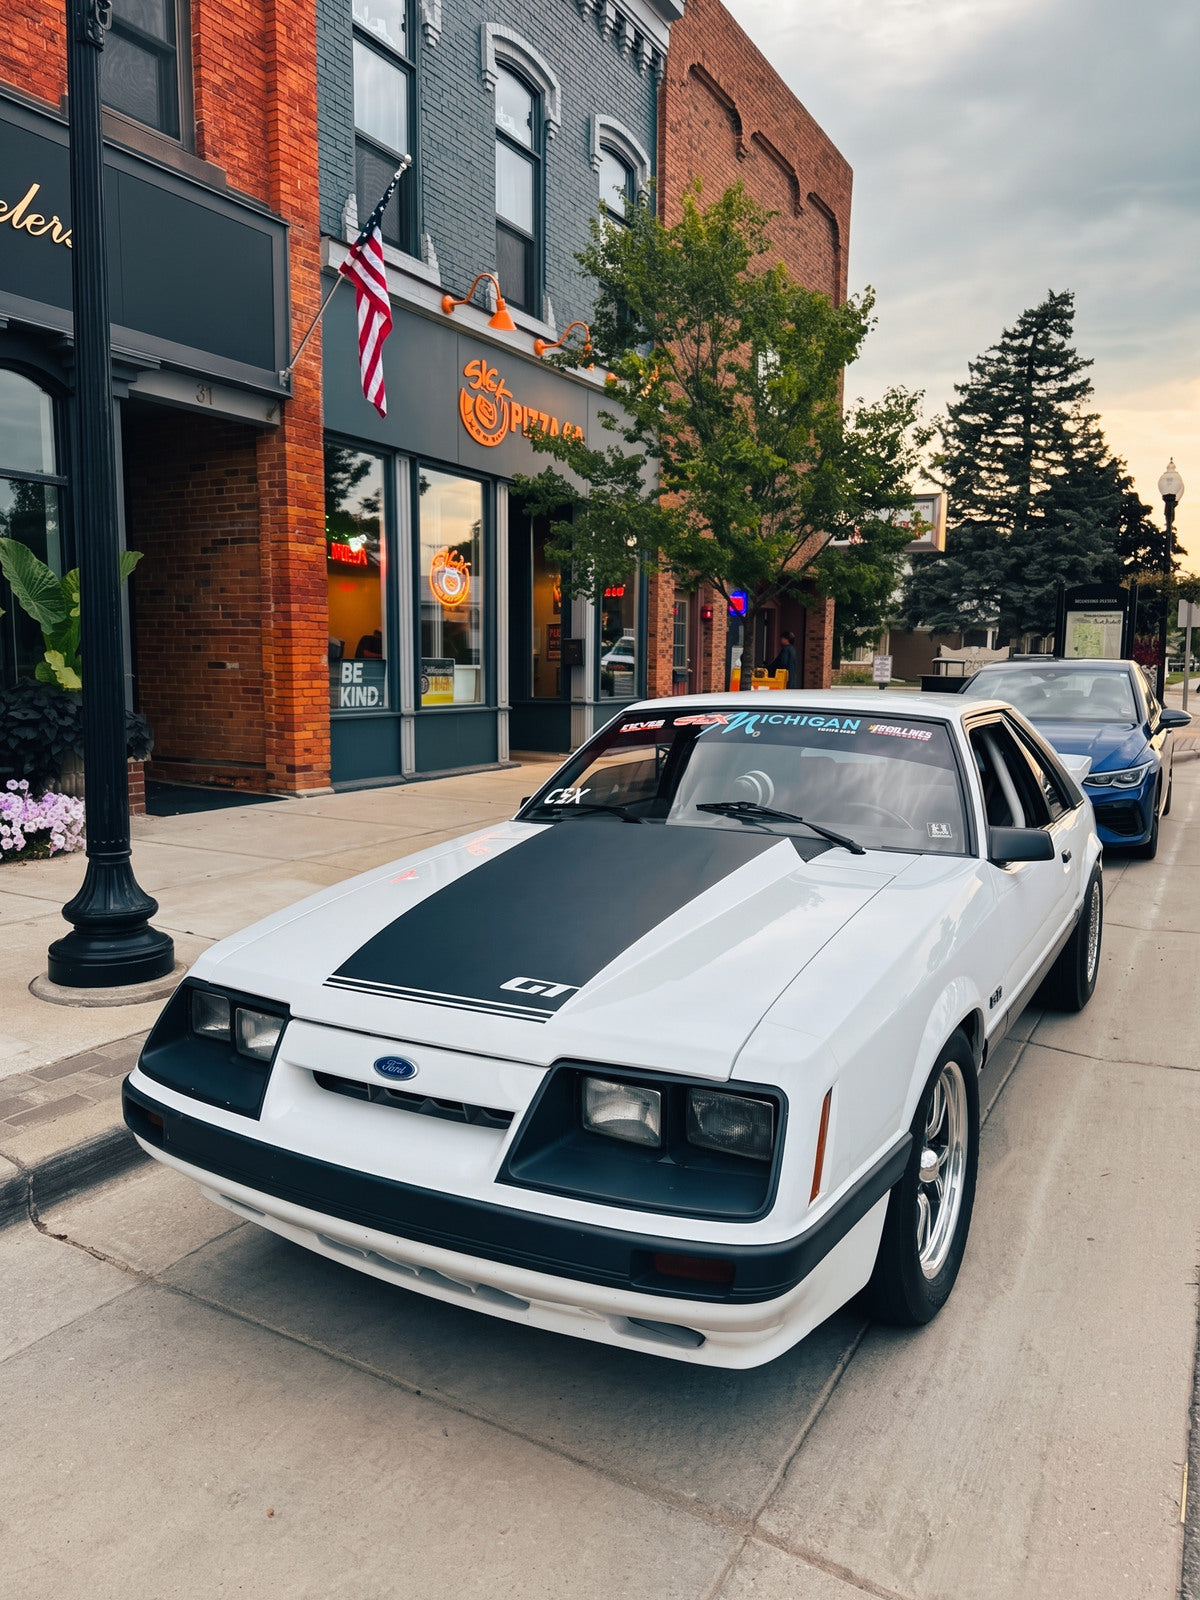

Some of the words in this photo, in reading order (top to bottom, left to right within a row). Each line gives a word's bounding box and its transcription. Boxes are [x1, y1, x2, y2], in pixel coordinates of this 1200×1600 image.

[196, 383, 214, 405] 31
[510, 400, 560, 440] PIZZA
[341, 662, 364, 684] BE
[340, 686, 383, 707] KIND.
[694, 711, 862, 739] MICHIGAN
[499, 976, 582, 998] GT
[382, 1059, 407, 1075] Ford
